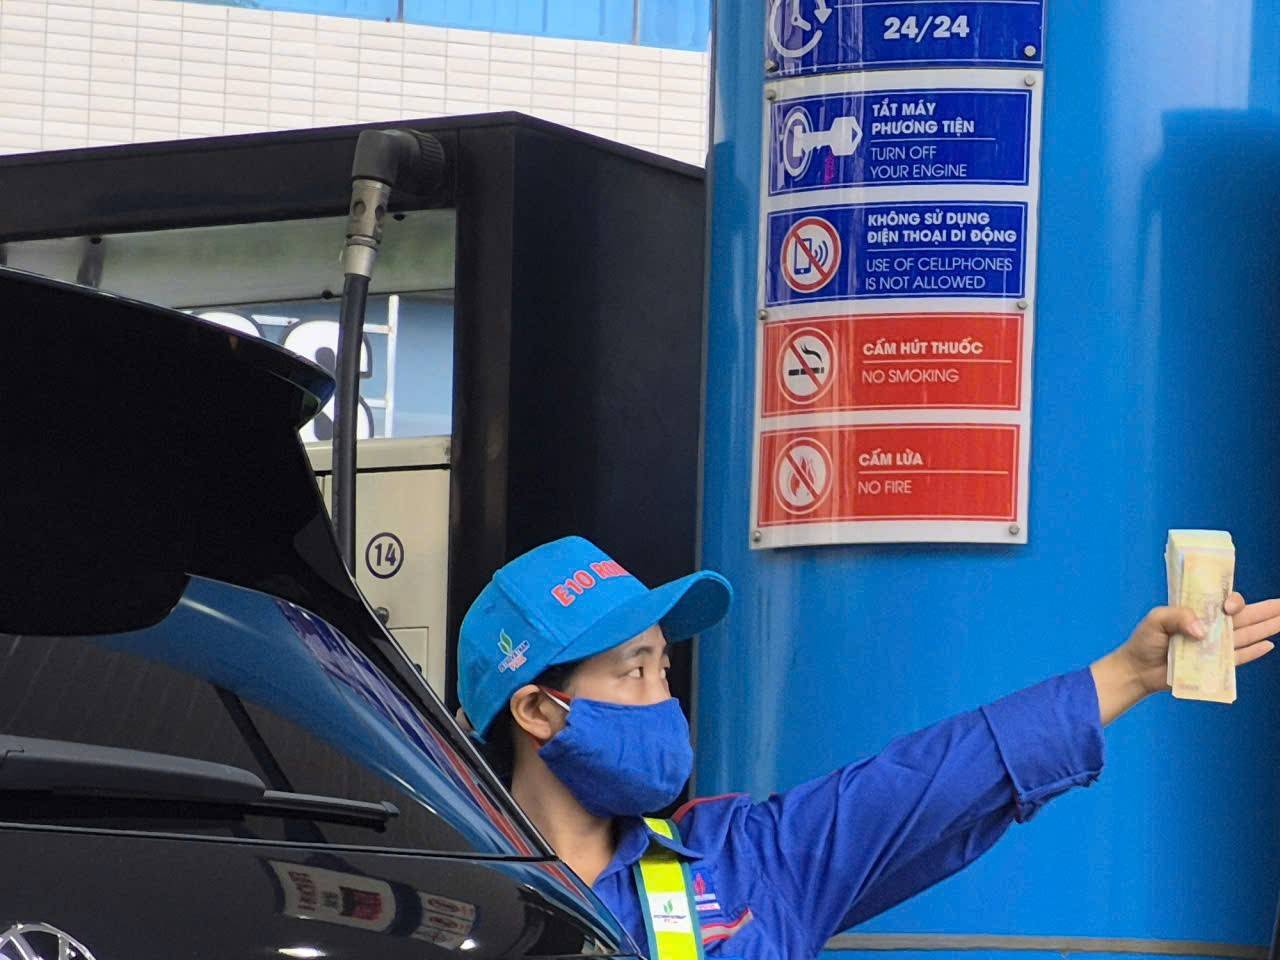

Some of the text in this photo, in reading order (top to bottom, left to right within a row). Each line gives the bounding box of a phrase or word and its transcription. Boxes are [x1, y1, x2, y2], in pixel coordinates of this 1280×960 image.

[883, 15, 970, 43] 24/24
[871, 100, 936, 117] TẮT MÁY
[872, 119, 975, 137] PHƯƠNG TIỆN
[870, 145, 937, 161] TURN OFF
[870, 164, 967, 179] YOUR ENGINE
[868, 208, 990, 228] KHÔNG SỬ DỤNG
[867, 227, 1017, 245] ĐIỆN THOẠI DI ĐỘNG
[866, 257, 1013, 272] USE OF CELLPHONES
[865, 276, 986, 290] IS NOT ALLOWED
[863, 337, 984, 355] CẤM HÚT THUỐC
[862, 368, 960, 384] NO SMOKING
[858, 448, 923, 466] CẤM LỬA
[858, 480, 912, 495] NO FIRE
[375, 543, 396, 567] 14
[551, 569, 596, 607] E10
